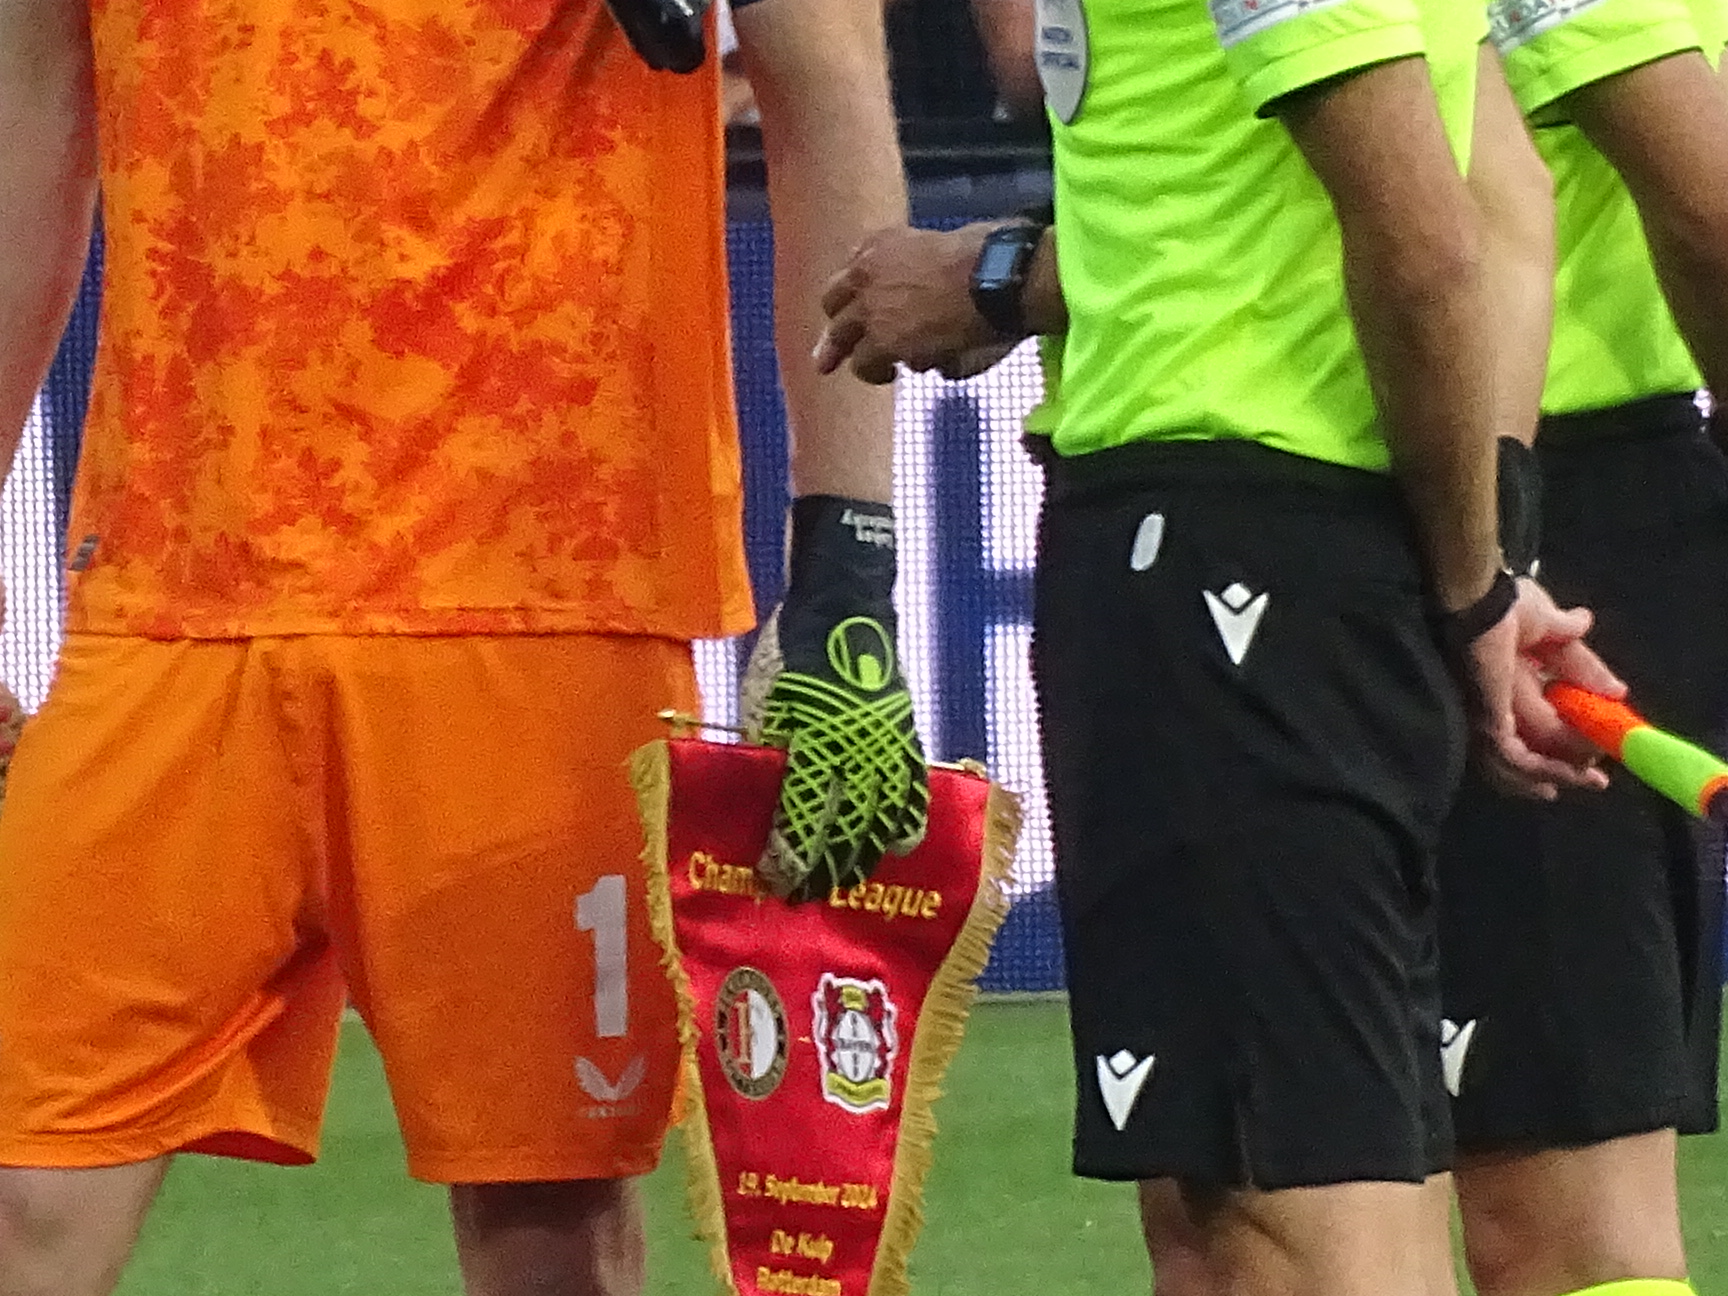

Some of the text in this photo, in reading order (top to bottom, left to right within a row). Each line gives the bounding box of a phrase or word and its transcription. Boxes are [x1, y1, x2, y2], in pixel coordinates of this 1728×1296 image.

[830, 880, 943, 920] League
[576, 874, 628, 1038] 1
[771, 1229, 794, 1256] De
